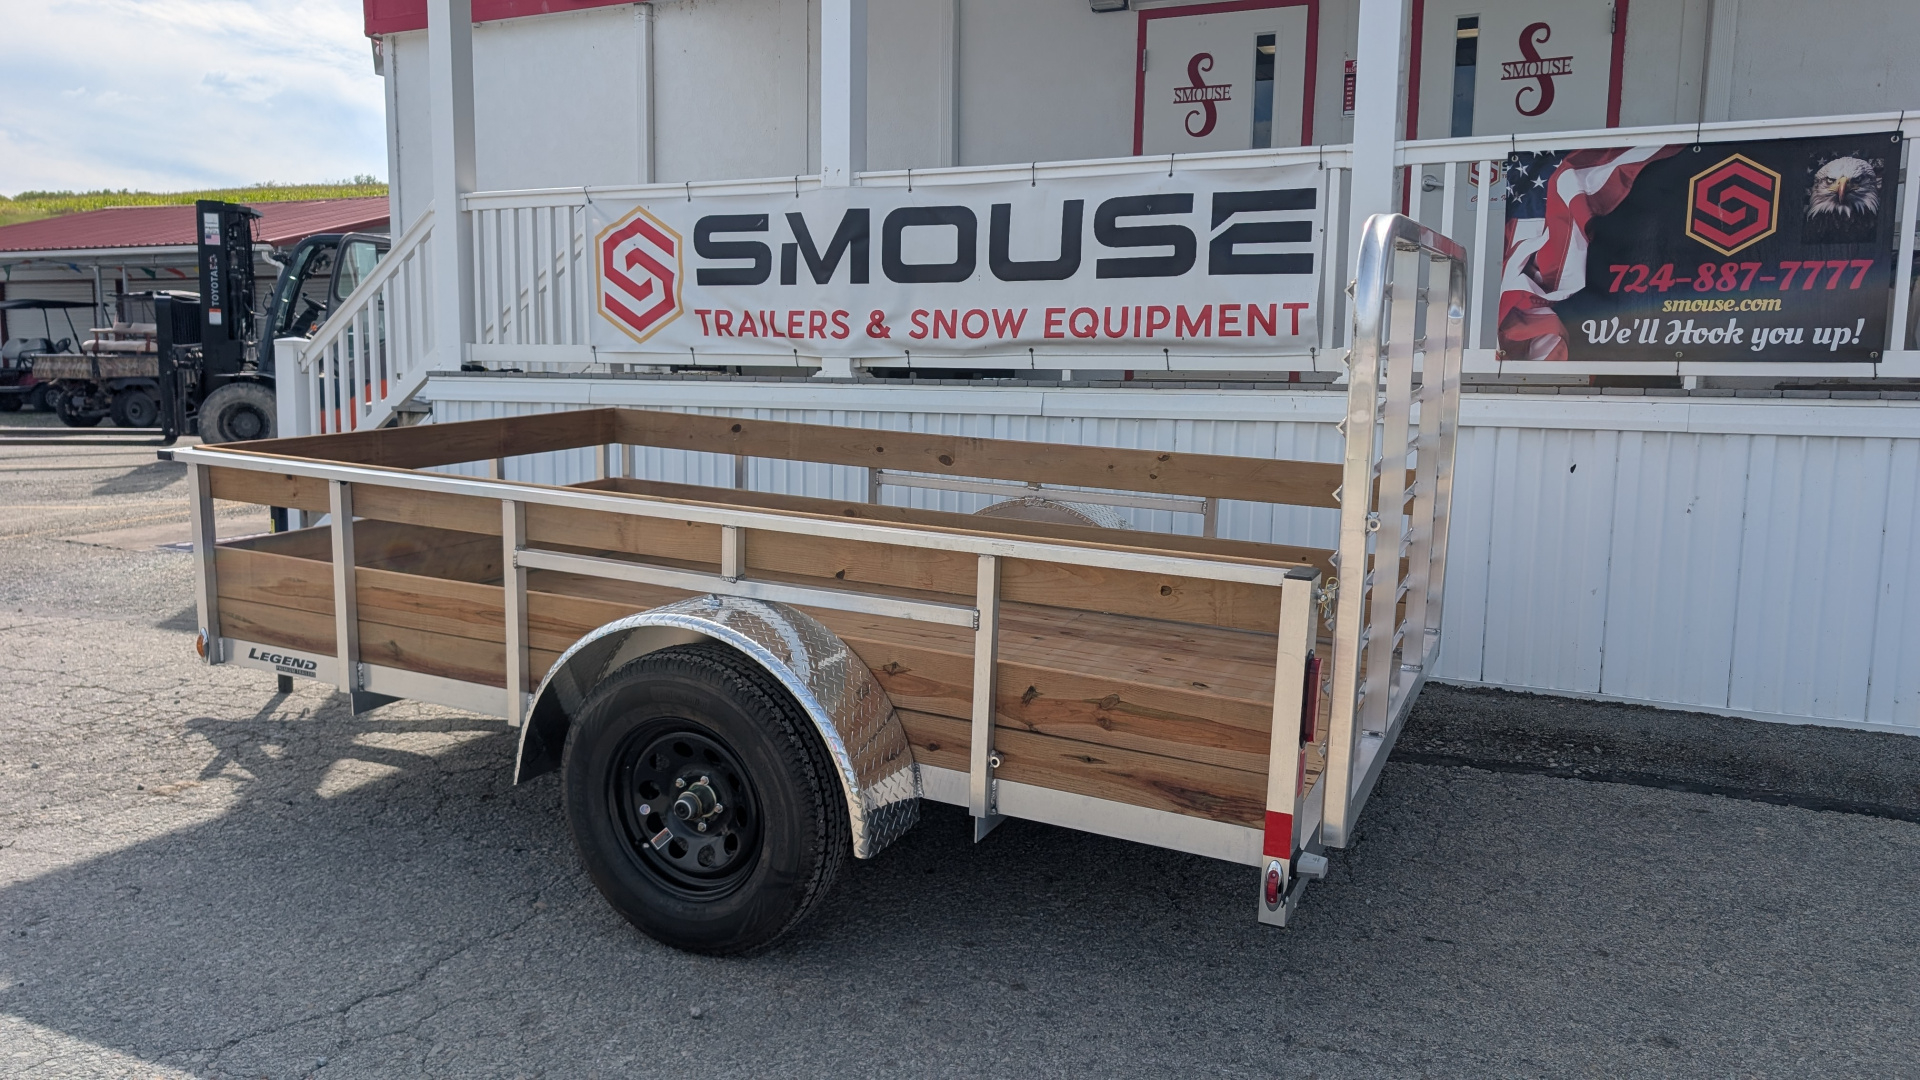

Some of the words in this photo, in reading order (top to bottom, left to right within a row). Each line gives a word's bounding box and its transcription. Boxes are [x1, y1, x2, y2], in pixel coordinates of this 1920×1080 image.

[1502, 58, 1572, 79] SMOUSE
[1174, 85, 1231, 103] SMOUSE
[693, 188, 1317, 286] SMOUSE
[211, 270, 219, 306] TOYOTA
[1609, 259, 1874, 293] 724-887-7777
[694, 309, 850, 339] TRAILERS
[865, 309, 891, 339] &
[909, 308, 1028, 339] SNOW
[1043, 302, 1310, 340] EQUIPMENT
[1662, 298, 1782, 313] smouse.com
[1581, 316, 1660, 345] We'll
[1664, 318, 1744, 345] Hook
[1750, 326, 1804, 351] you
[1812, 318, 1866, 351] up!
[249, 648, 317, 669] LEGEND
